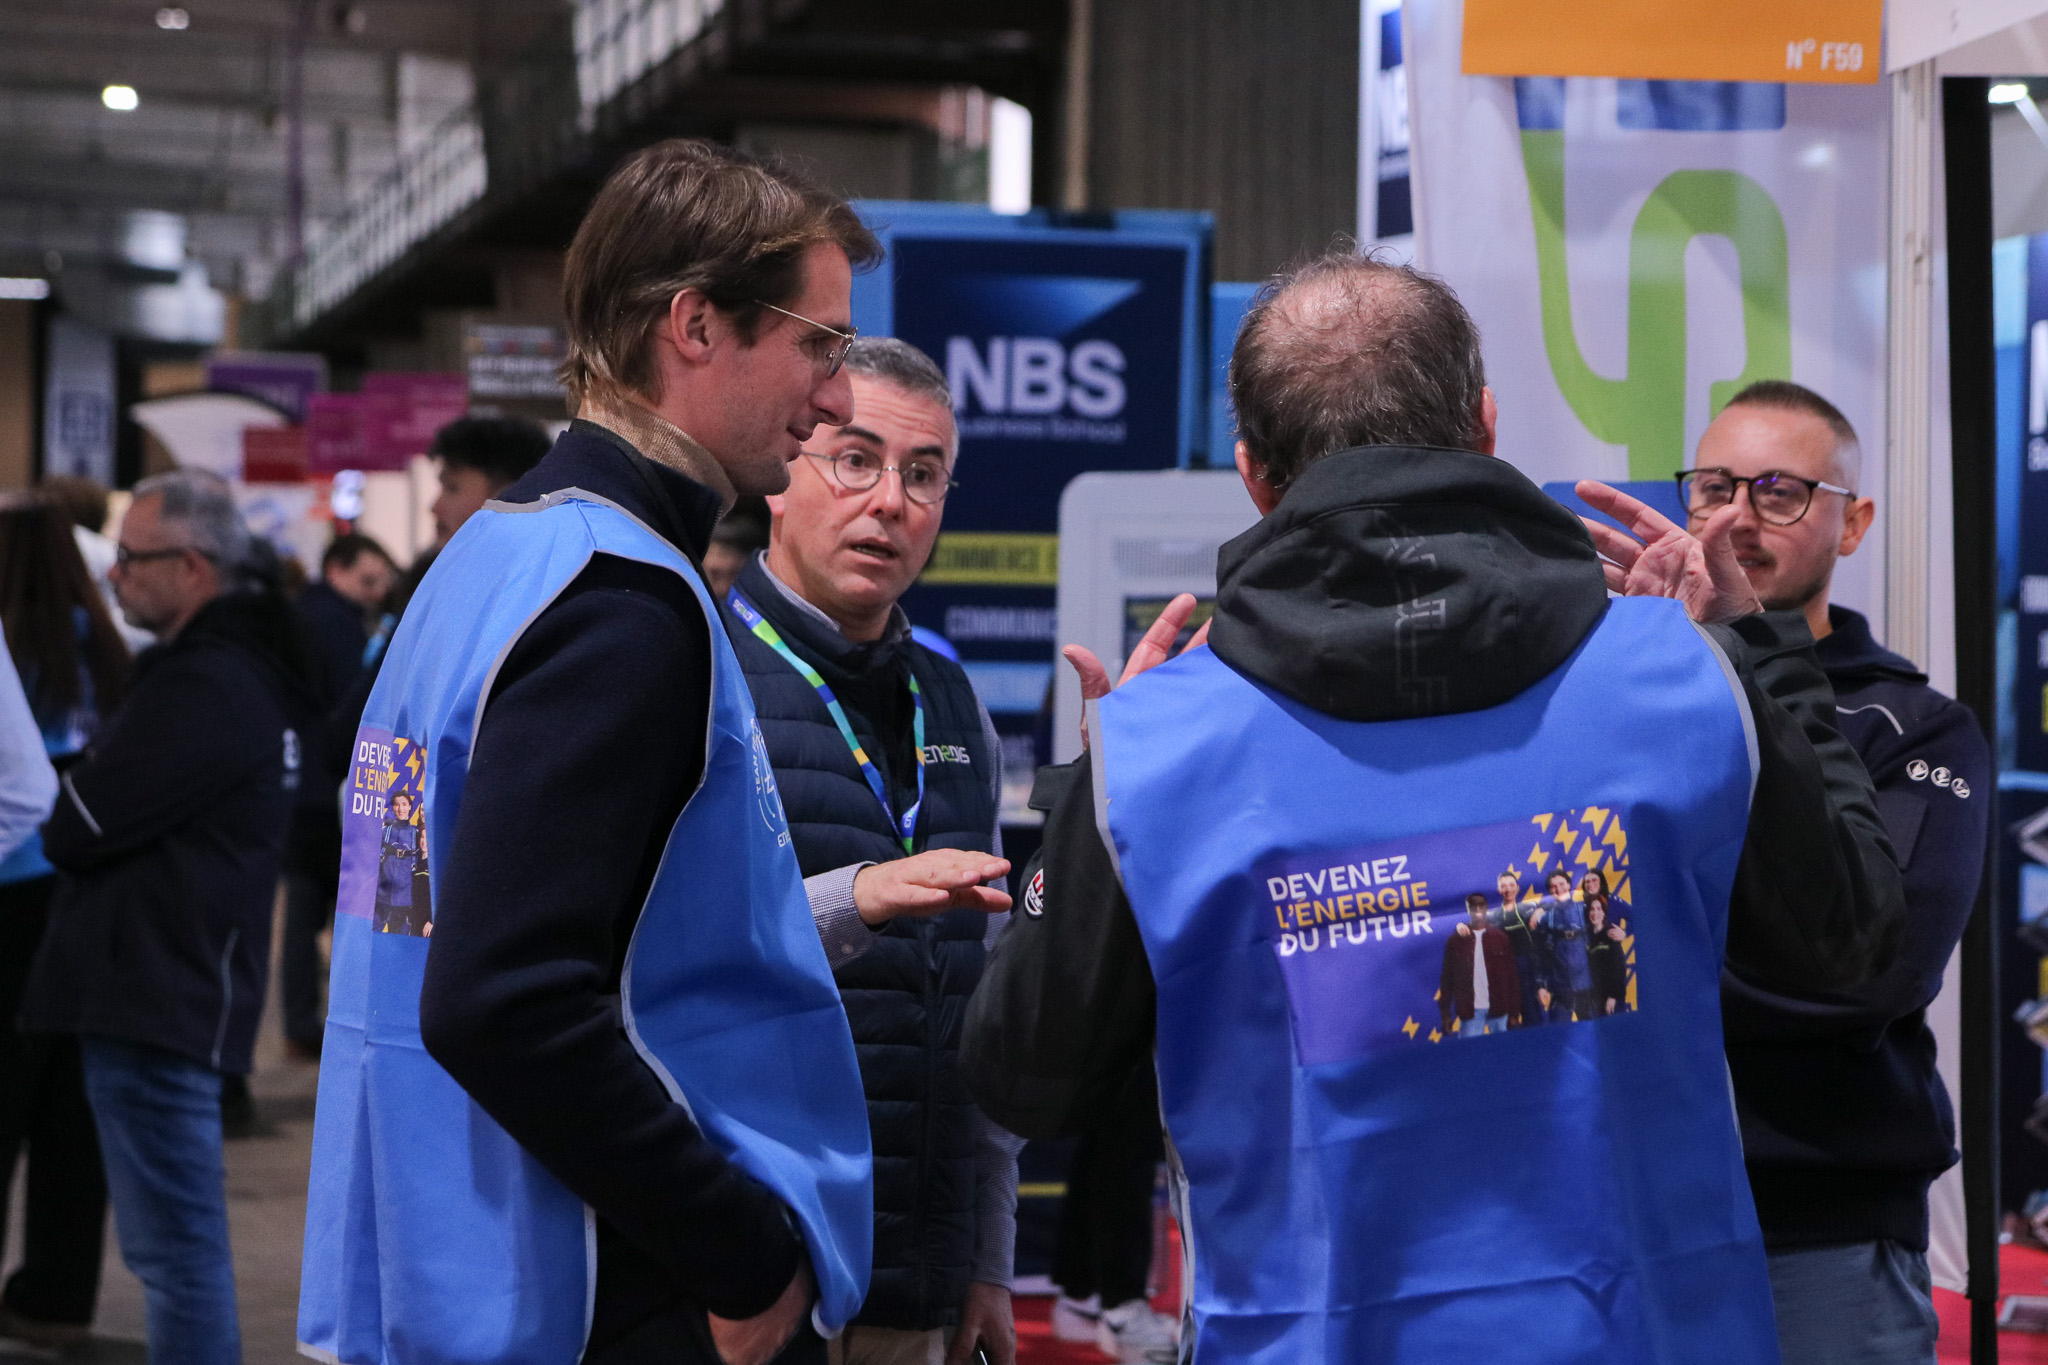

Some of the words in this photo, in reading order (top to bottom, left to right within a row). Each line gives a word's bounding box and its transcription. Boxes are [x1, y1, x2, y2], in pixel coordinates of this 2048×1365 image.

[946, 335, 1127, 418] NBS
[352, 792, 373, 816] DU
[1267, 854, 1411, 901] DEVENEZ
[1275, 881, 1430, 929] L'ÉNERGIE
[1280, 927, 1320, 957] DU
[1328, 910, 1433, 949] FUTUR
